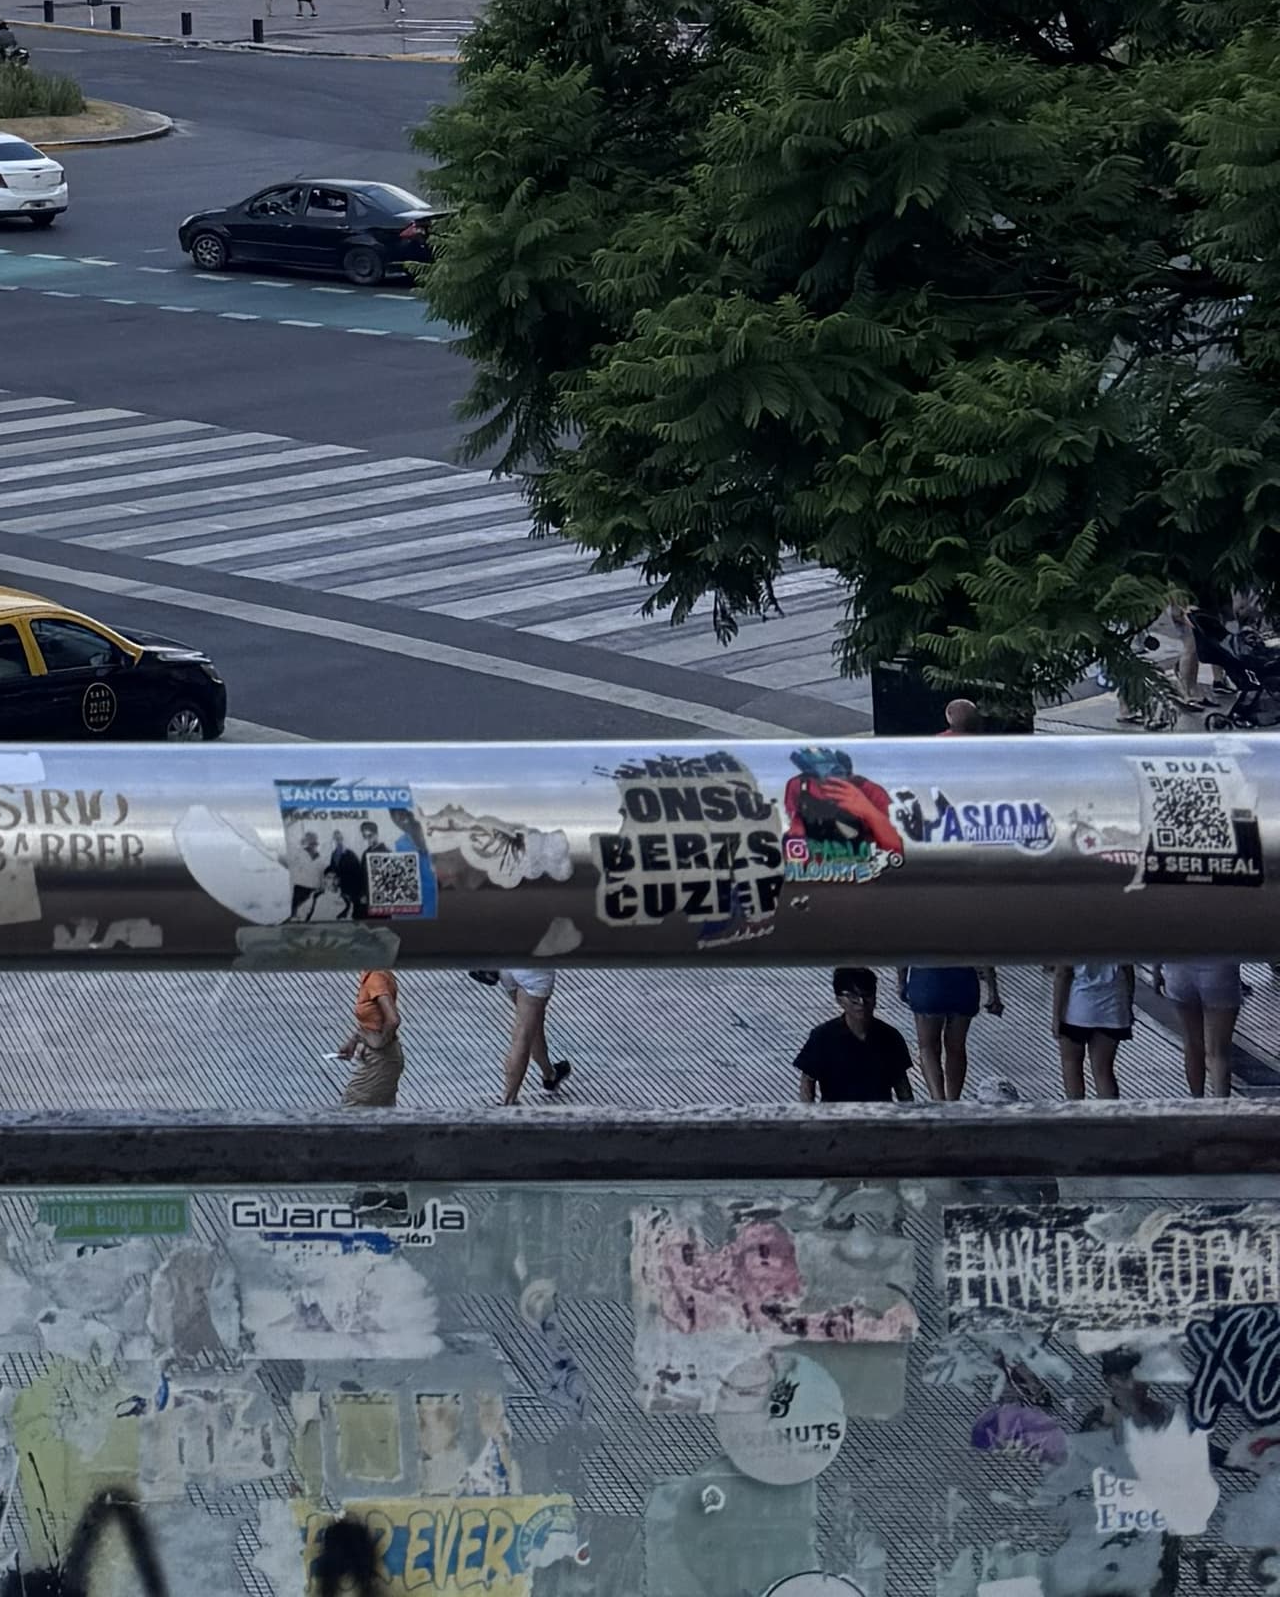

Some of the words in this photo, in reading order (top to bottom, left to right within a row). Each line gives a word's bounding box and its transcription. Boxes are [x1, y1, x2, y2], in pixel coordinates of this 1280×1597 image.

[1165, 761, 1231, 775] DUAL
[282, 788, 350, 802] SANTOS
[353, 788, 410, 802] BRAVO
[330, 810, 368, 819] SINGLE
[1165, 857, 1202, 874] SER
[1207, 857, 1260, 875] REAL
[1099, 1472, 1134, 1497] Be
[1100, 1503, 1166, 1530] Free
